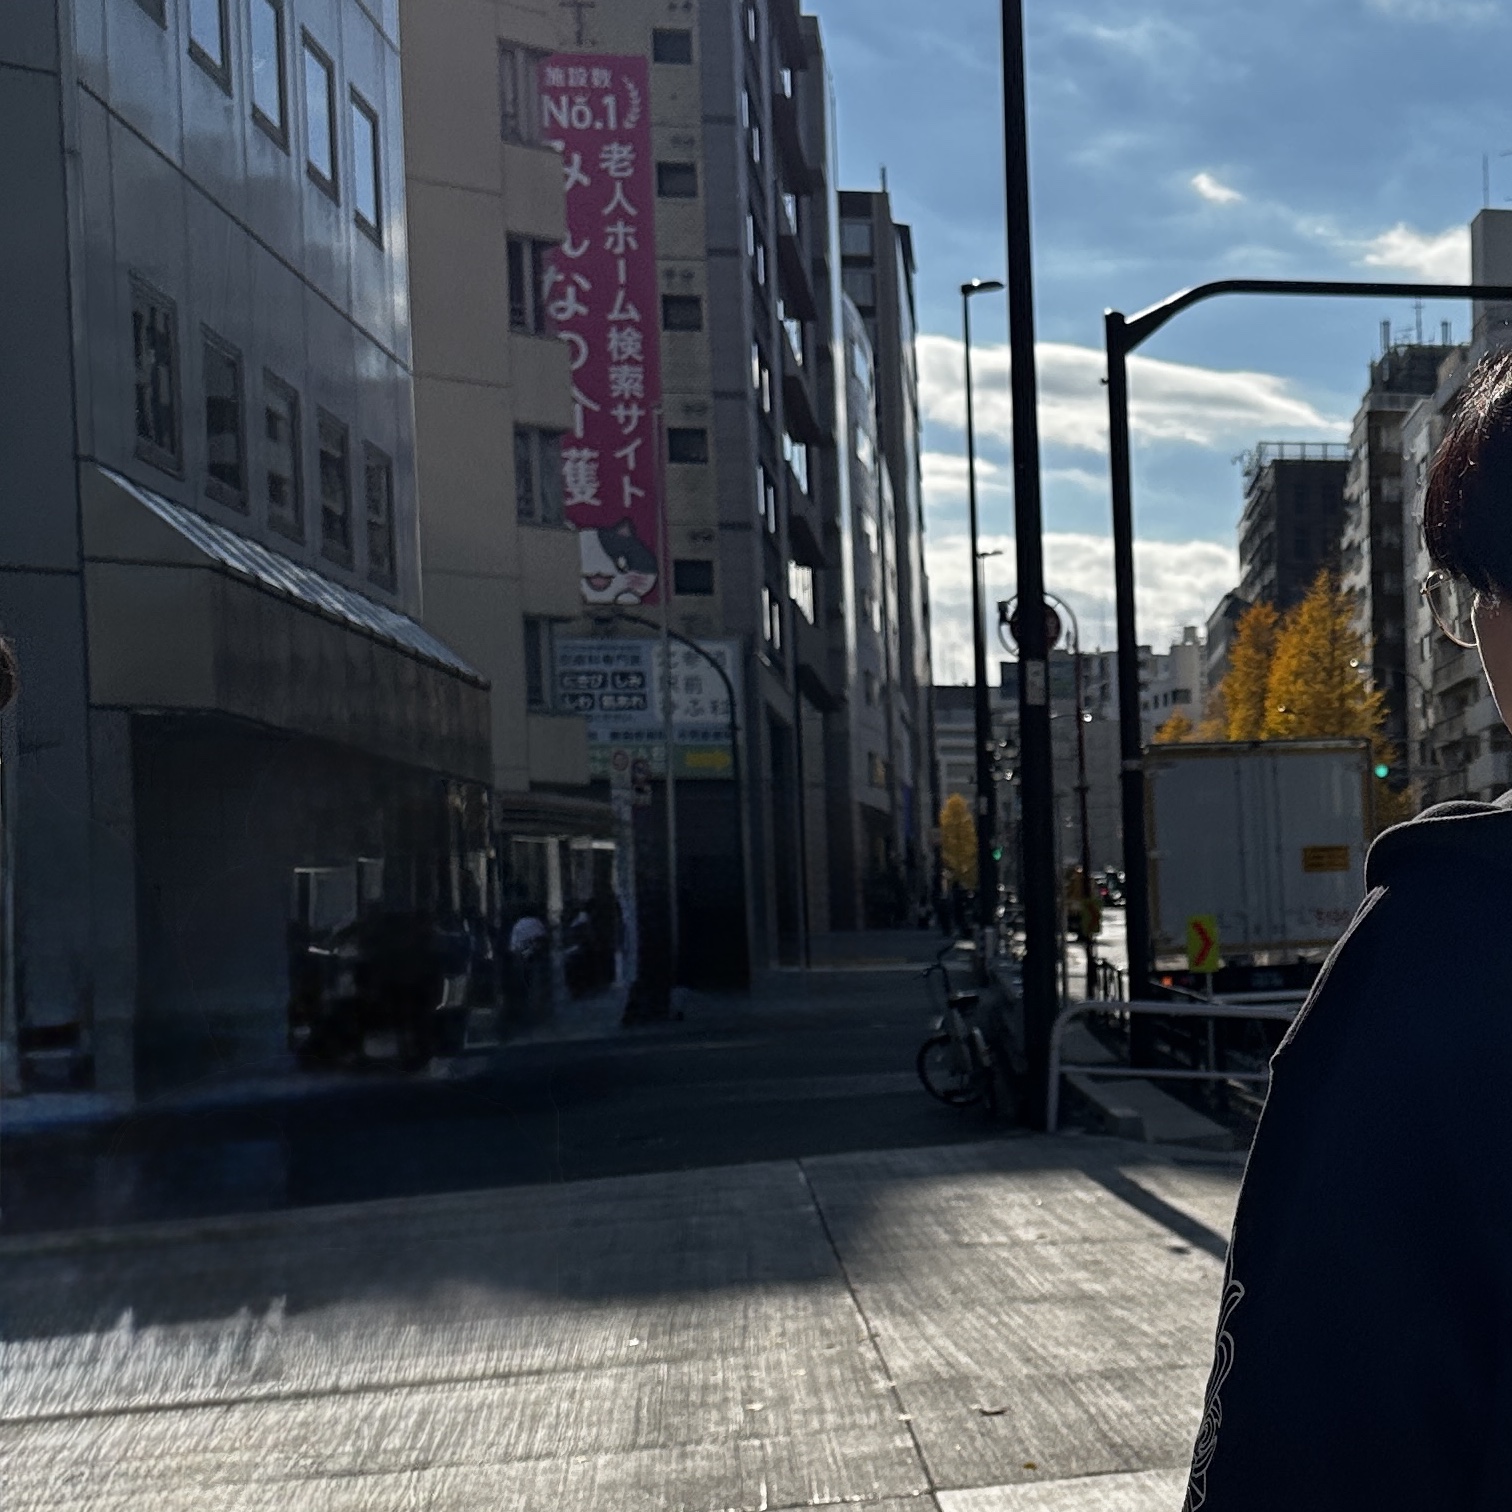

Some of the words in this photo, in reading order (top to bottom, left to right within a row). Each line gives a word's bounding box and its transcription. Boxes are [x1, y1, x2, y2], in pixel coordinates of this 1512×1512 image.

[545, 66, 613, 88] 施設数
[541, 94, 618, 131] No.1
[599, 142, 646, 508] 老人ホーム検索サイト
